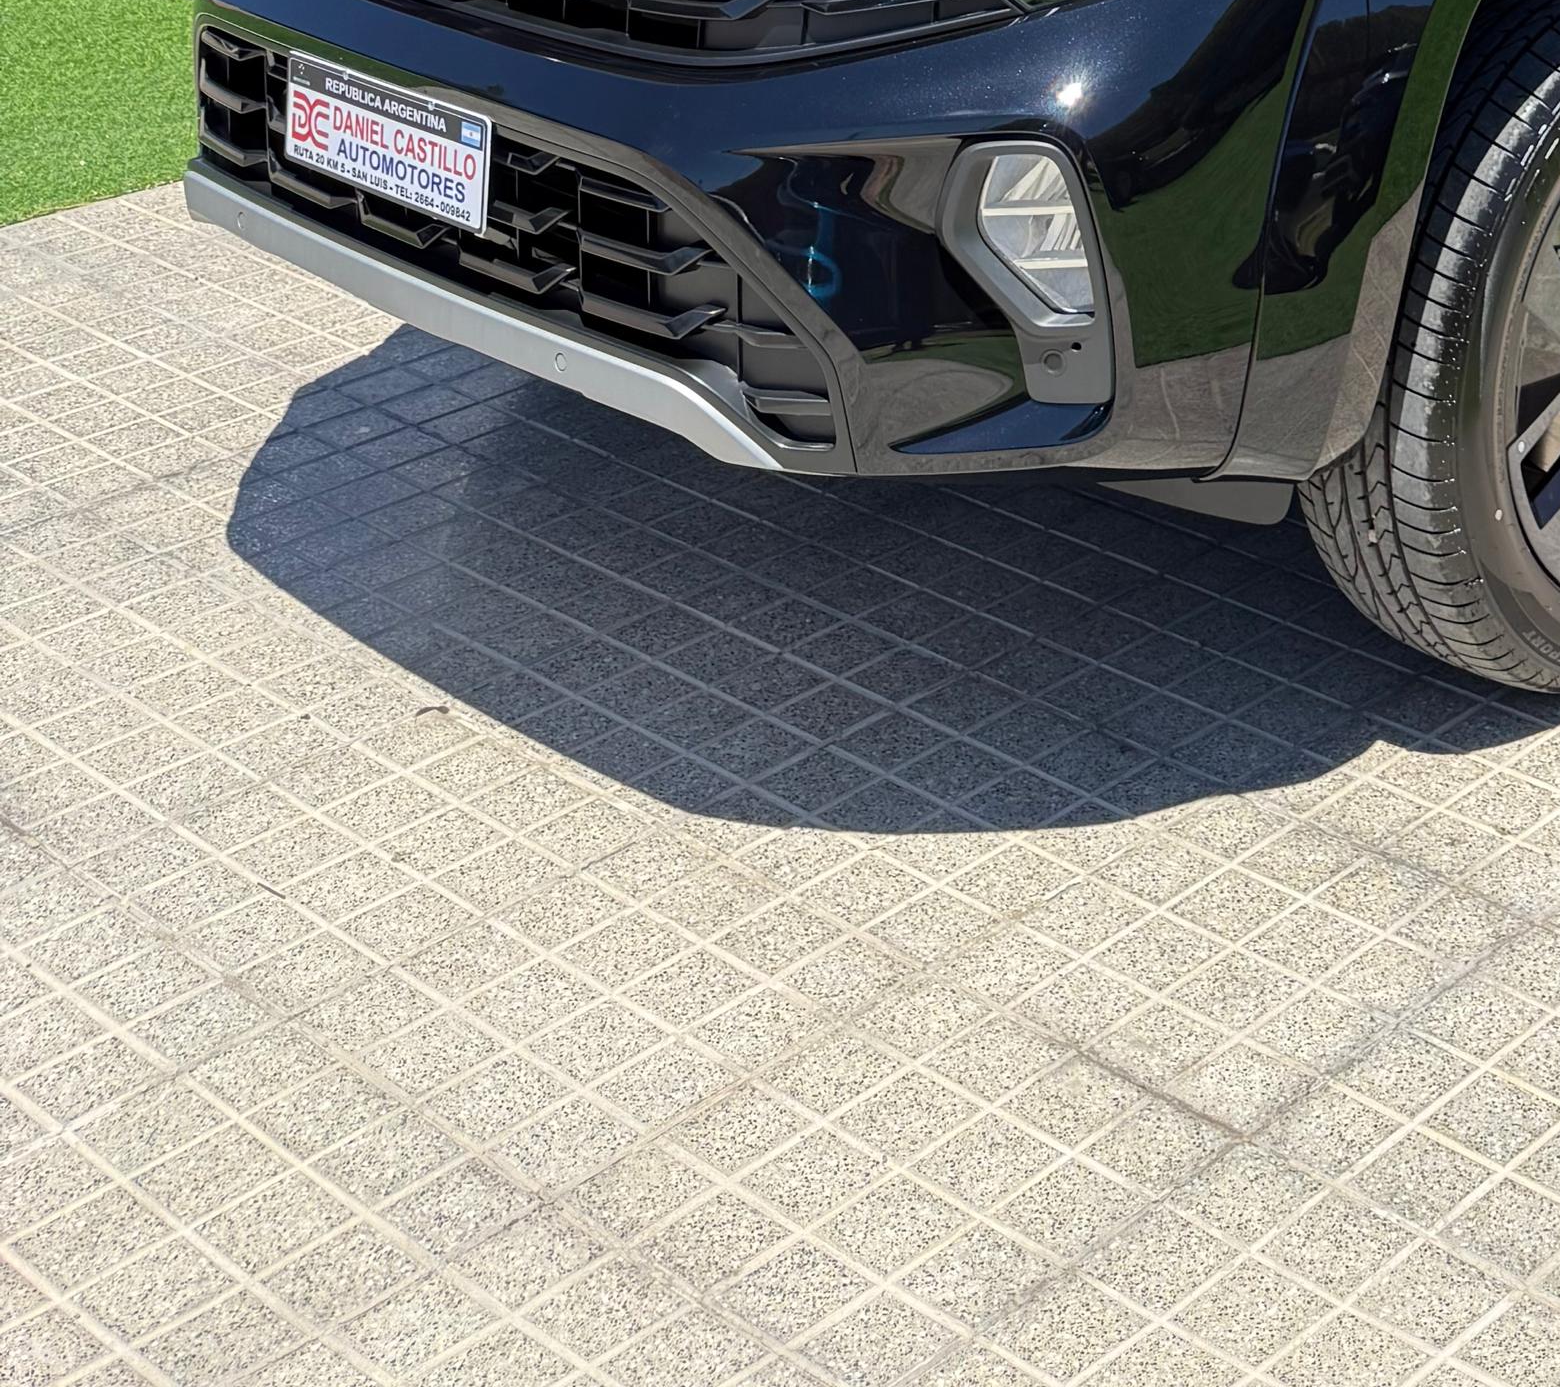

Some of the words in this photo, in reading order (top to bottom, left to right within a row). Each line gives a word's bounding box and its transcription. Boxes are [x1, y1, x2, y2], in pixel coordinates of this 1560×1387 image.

[325, 77, 382, 111] REPUBLICA
[383, 99, 447, 132] ARGENTINA
[294, 144, 314, 161] RUTA
[315, 152, 325, 165] 20
[326, 157, 339, 171] KM
[351, 167, 368, 183] SAN
[369, 174, 388, 191] LUIS
[394, 184, 413, 200] TEL:
[332, 106, 389, 150] DANIEL
[393, 129, 477, 180] CASTILLO
[337, 138, 466, 204] AUTOMOTORES
